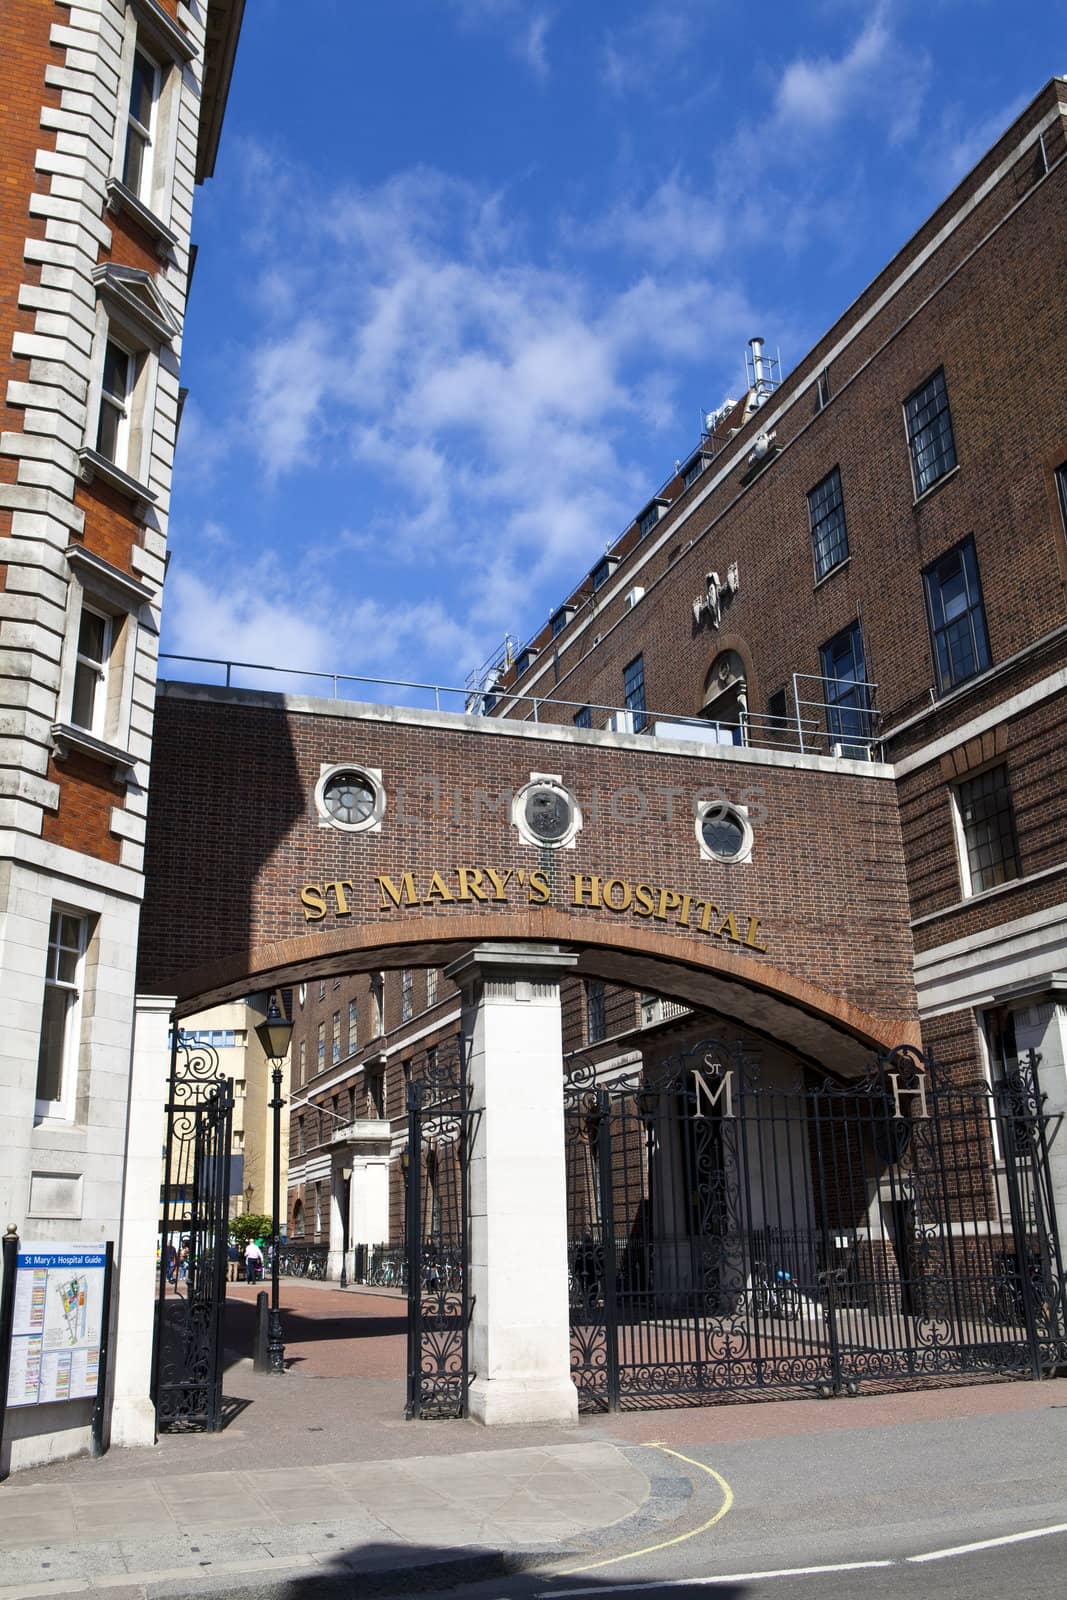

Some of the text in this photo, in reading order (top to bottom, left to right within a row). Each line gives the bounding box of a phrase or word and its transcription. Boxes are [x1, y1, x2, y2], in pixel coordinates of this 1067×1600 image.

[300, 866, 768, 953] ST MARY'S HOSPITAL
[691, 1070, 736, 1118] M
[887, 1073, 932, 1119] H
[24, 1255, 102, 1266] St Mary's Hospital Guide
